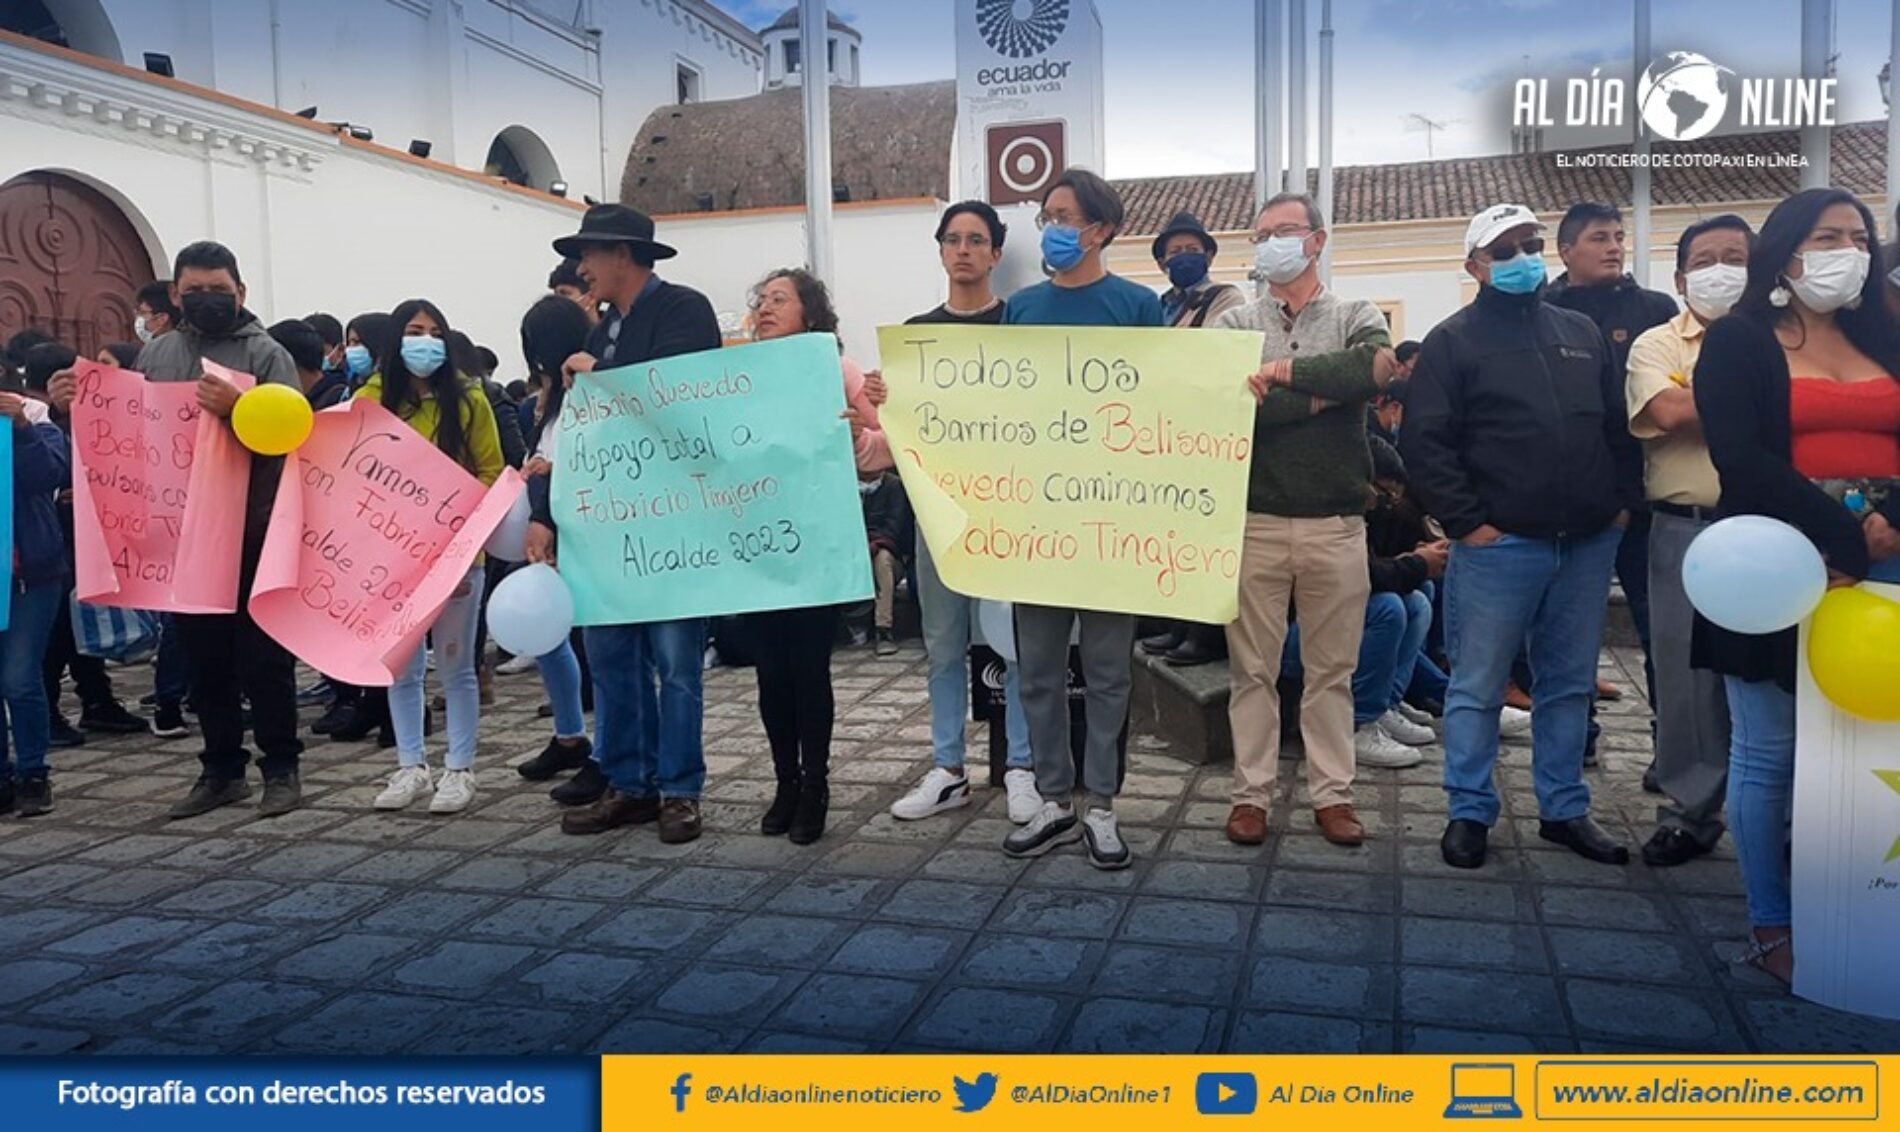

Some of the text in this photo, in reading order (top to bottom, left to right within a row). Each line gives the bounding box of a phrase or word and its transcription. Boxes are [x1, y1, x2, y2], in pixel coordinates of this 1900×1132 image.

[977, 59, 1072, 86] ecuador
[987, 85, 1018, 97] ama
[1034, 81, 1062, 93] vida
[79, 369, 117, 409] Por
[648, 367, 752, 410] Quevedo
[904, 336, 1140, 393] Todos los
[341, 410, 429, 507] Vamos
[568, 415, 762, 482] Apoyo total a
[914, 402, 1251, 461] Barrios de Belisario
[575, 485, 690, 524] Fabricio
[302, 523, 354, 574] alde
[622, 519, 802, 577] Alcalde 2023
[963, 516, 1239, 597] abricio Tinajero
